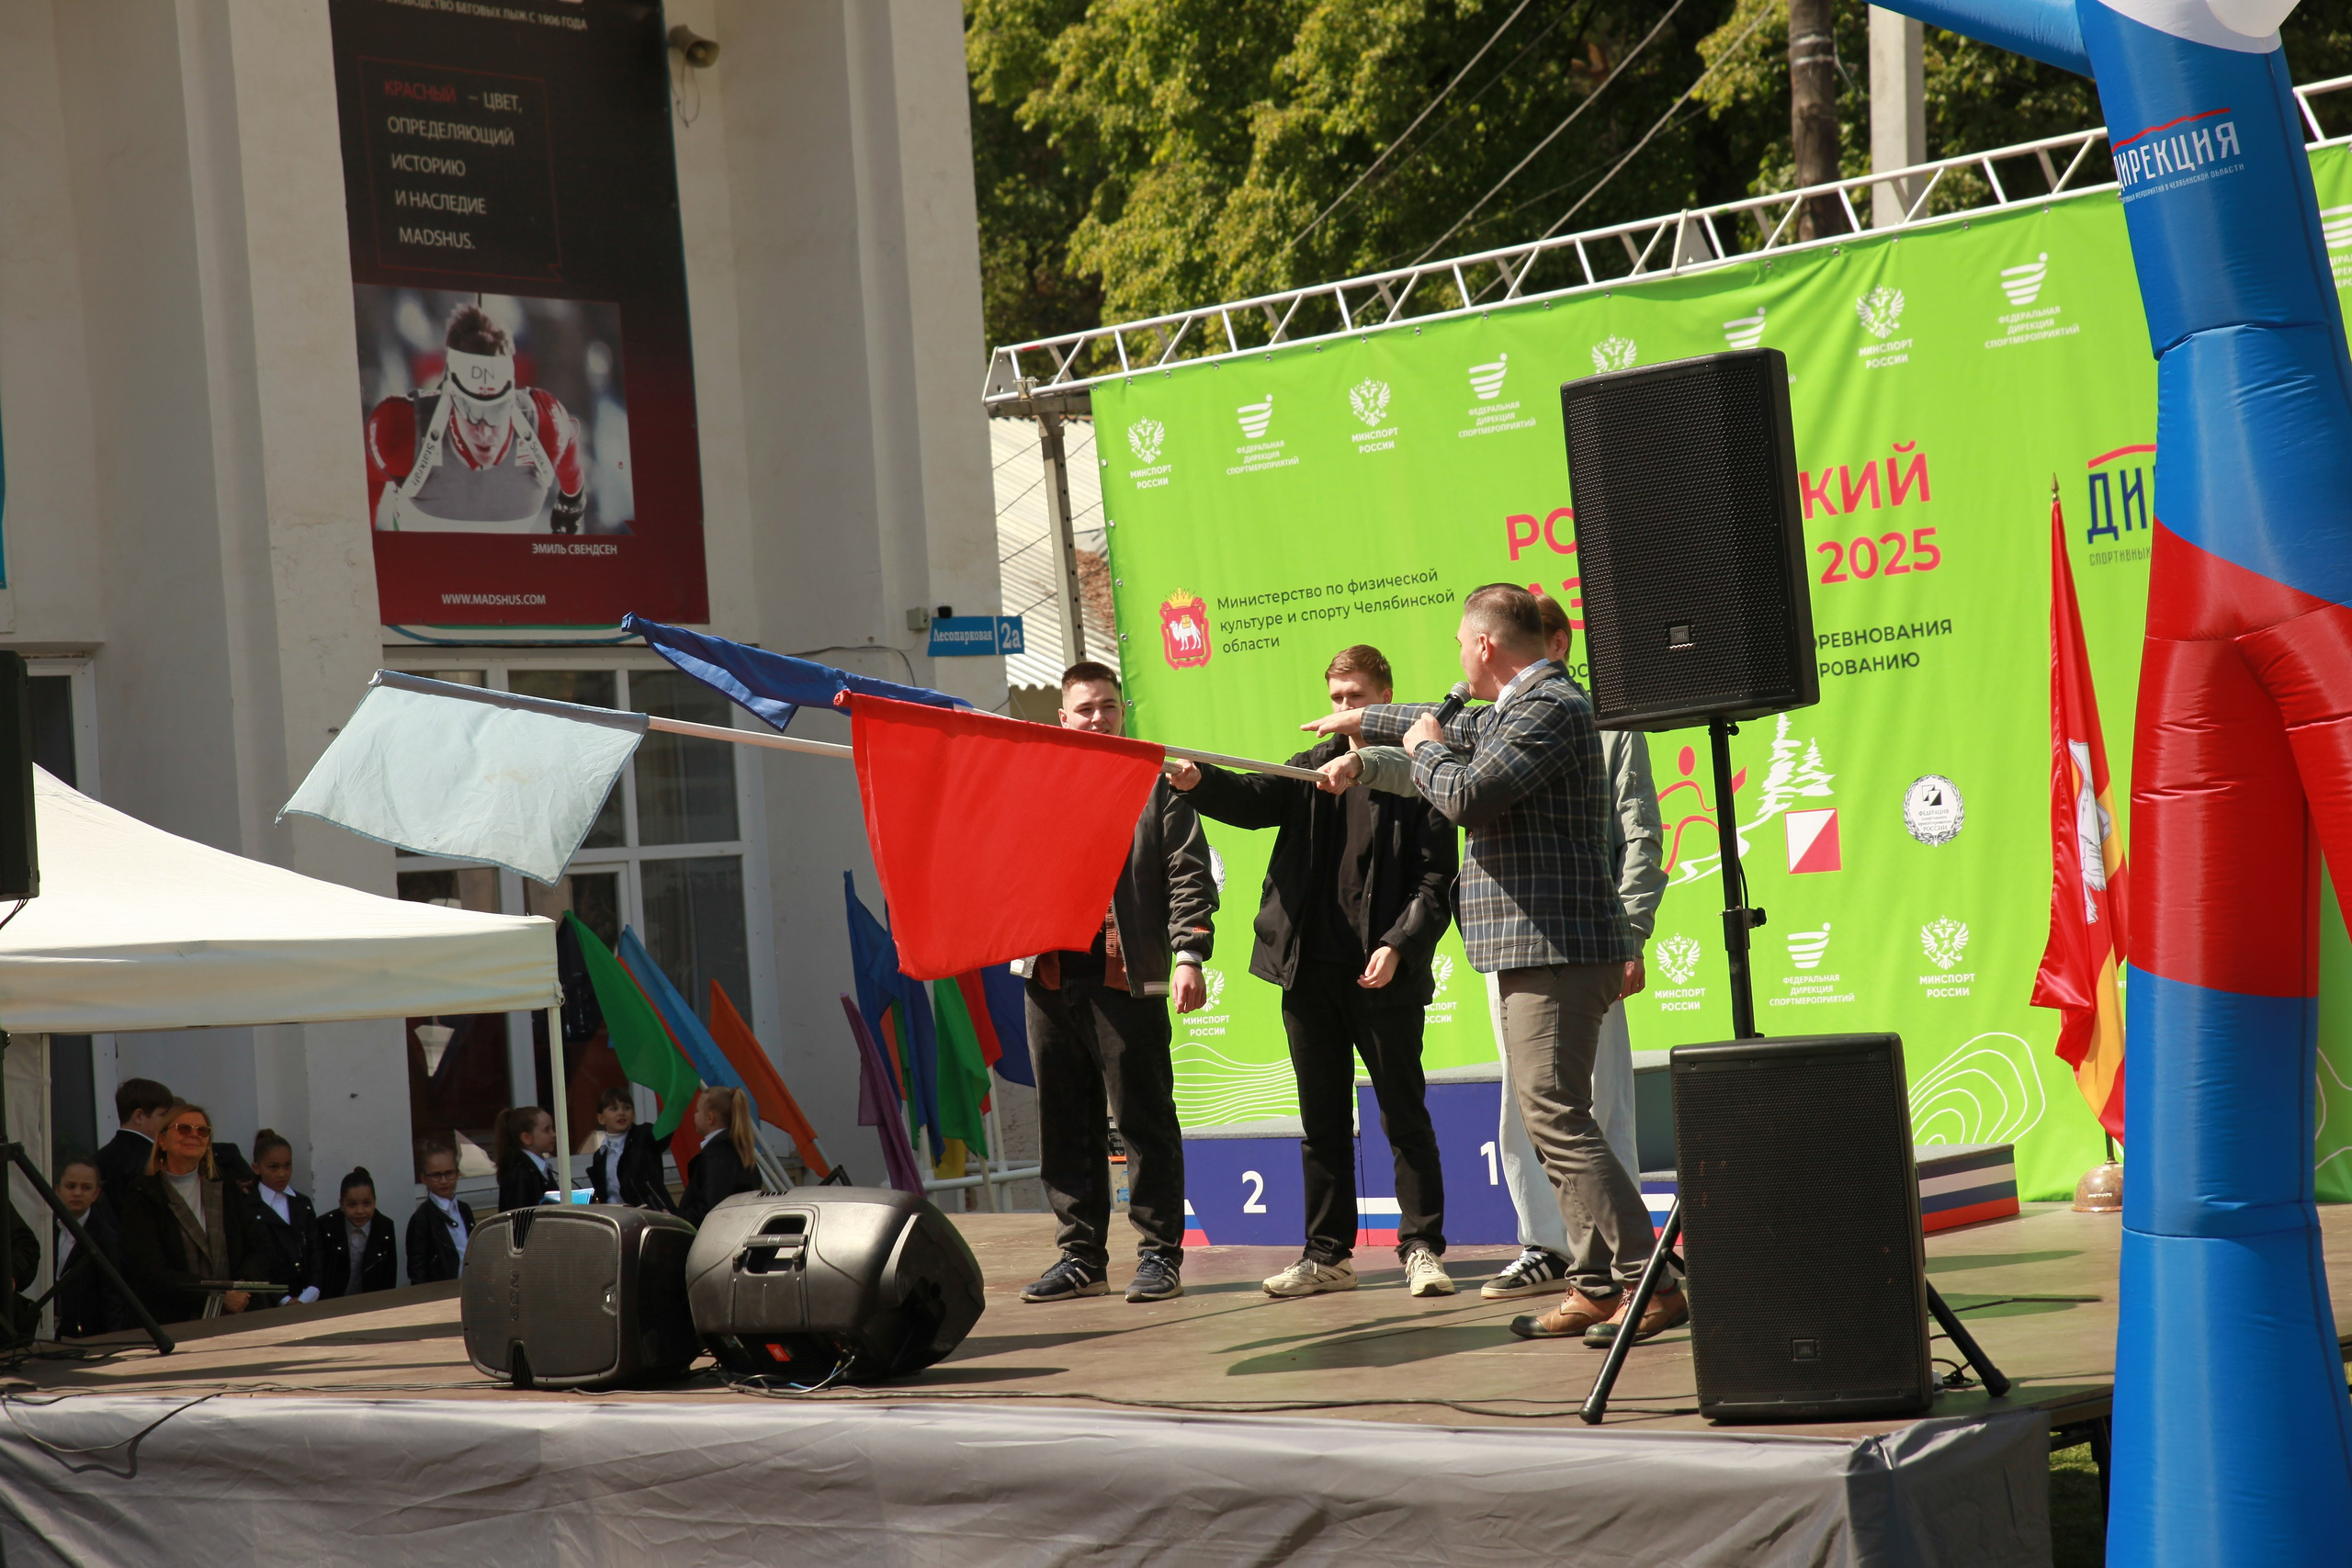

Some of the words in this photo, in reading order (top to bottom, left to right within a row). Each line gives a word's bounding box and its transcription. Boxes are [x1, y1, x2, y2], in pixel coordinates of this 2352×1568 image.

[456, 2, 502, 18] БЕГОВЫХ
[503, 8, 527, 21] ЛЫЖ
[528, 12, 536, 23] С
[537, 13, 561, 27] 1906
[561, 17, 588, 30] ГОДА
[384, 79, 457, 104] КРАСНЫЙ
[483, 92, 523, 114] ЦВЕТ,
[388, 117, 514, 147] ОПРЕДЕЛЯЮЩИЙ
[391, 153, 466, 177] ИСТОРИЮ
[2113, 121, 2241, 192] ДИРЕКЦИЯ
[2169, 172, 2210, 189] ЧЕЛЯБИНСКОЙ
[2211, 164, 2245, 178] ОБЛАСТИ
[395, 189, 407, 207] И
[410, 191, 487, 215] НАСЛЕДИЕ
[399, 227, 476, 250] MADSHUS.
[1998, 306, 2061, 324] ФЕДЕРАЛЬНАЯ
[2007, 318, 2054, 335] ДИРЕКЦИЯ
[1984, 323, 2080, 349] СПОРТМЕРОПРИЯТИЙ
[1859, 338, 1914, 356] МИНСПОРТ
[1866, 354, 1909, 369] РОССИИ
[1468, 400, 1521, 416] ФЕДЕРАЛЬНАЯ
[1458, 417, 1536, 438] СПОРТМЕРОПРИЯТИЙ
[1476, 412, 1516, 426] ДИРЕКЦИЯ
[1351, 427, 1398, 443] МИНСПОРТ
[1236, 440, 1285, 455] ФЕДЕРАЛЬНАЯ
[1359, 440, 1395, 454] РОССИИ
[1226, 456, 1300, 475] СПОРТМЕРОПРИЯТИЙ
[1243, 450, 1281, 464] ДИРЕКЦИЯ
[1130, 464, 1172, 479] МИНСПОРТ
[1136, 477, 1169, 490] РОССИИ
[532, 543, 567, 555] ЭМИЛЬ
[568, 544, 617, 557] СВЕНДСЕН
[1815, 526, 1942, 585] 2025
[2089, 547, 2152, 566] СПОРТИВНЫХ
[1217, 585, 1322, 611] Министерство
[1326, 582, 1343, 597] по
[1347, 569, 1438, 596] физической
[442, 593, 546, 605] WWW.MADSHUS.COM
[1219, 613, 1283, 633] культуре
[1287, 611, 1297, 624] и
[1301, 604, 1351, 626] спорту
[1354, 589, 1455, 615] Челябинской
[933, 628, 993, 645] Лесопарковая
[1001, 622, 1022, 649] 2а
[1815, 618, 1952, 649] РЕВНОВАНИЯ
[1222, 635, 1280, 654] области
[1819, 651, 1920, 678] РОВАНИЮ
[1918, 808, 1950, 817] ФЕДЕРАЦИЯ
[1782, 974, 1840, 986] ФЕДЕРАЛЬНАЯ
[1919, 973, 1975, 986] МИНСПОРТ
[1655, 987, 1706, 999] МИНСПОРТ
[1769, 992, 1855, 1007] СПОРТМЕРОПРИЯТИЙ
[1790, 985, 1834, 997] ДИРЕКЦИЯ
[1927, 987, 1970, 998] РОССИИ
[1424, 1001, 1457, 1010] НСПОРТ
[1661, 1000, 1701, 1011] РОССИИ
[1182, 1014, 1230, 1025] МИНСПОРТ
[1424, 1014, 1452, 1024] ОССИИ
[1190, 1027, 1226, 1036] РОССИИ
[1479, 1141, 1499, 1186] 1
[1241, 1169, 1267, 1213] 2
